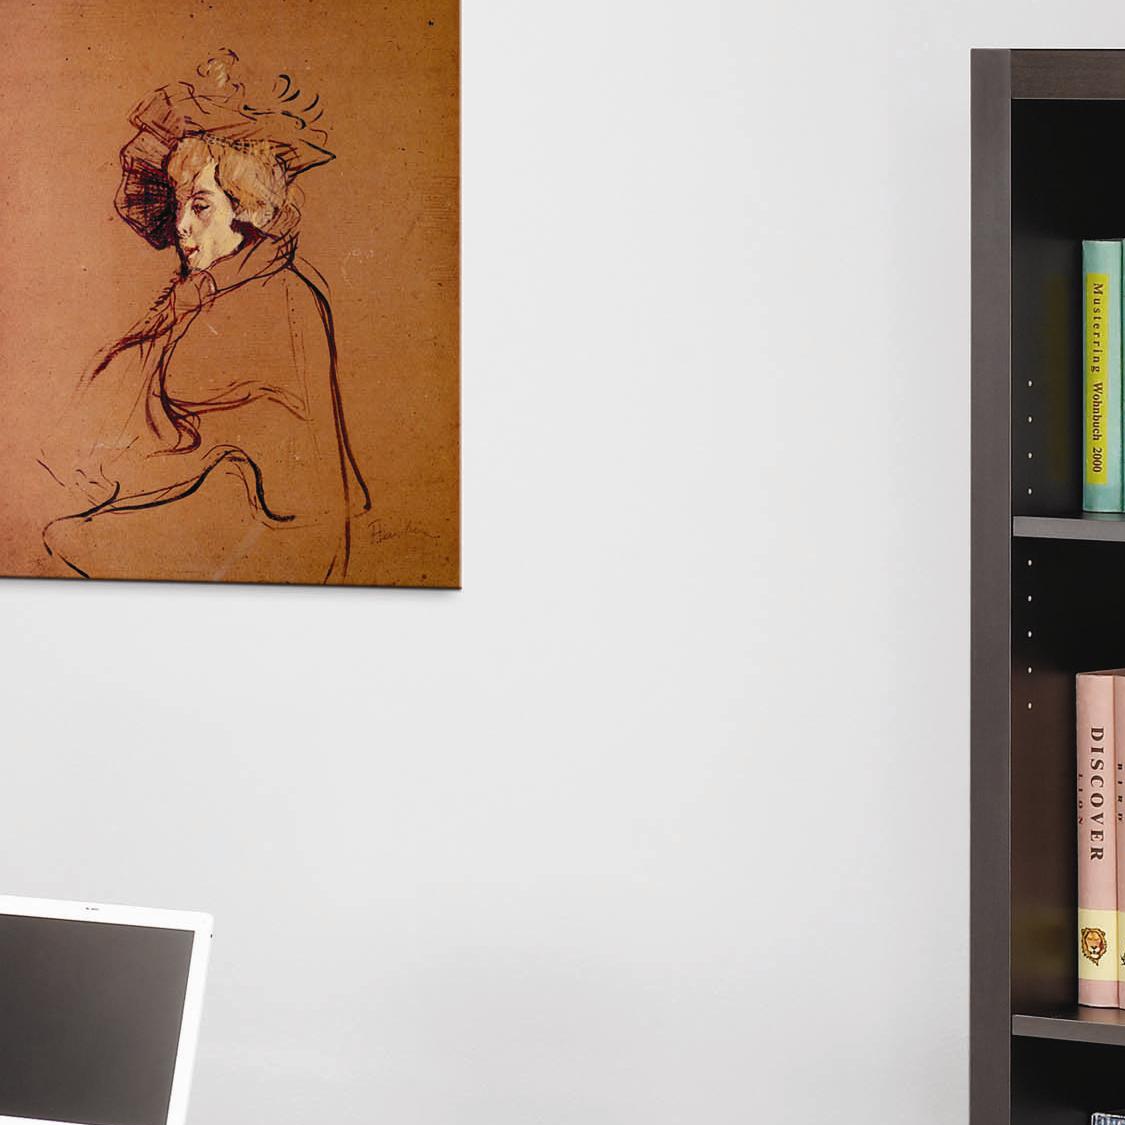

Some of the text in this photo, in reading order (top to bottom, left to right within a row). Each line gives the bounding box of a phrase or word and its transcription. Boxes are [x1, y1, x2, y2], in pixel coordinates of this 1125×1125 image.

[1092, 382, 1104, 441] Wohnbuch
[1092, 447, 1104, 473] 2000
[1090, 727, 1104, 861] DISCOVER
